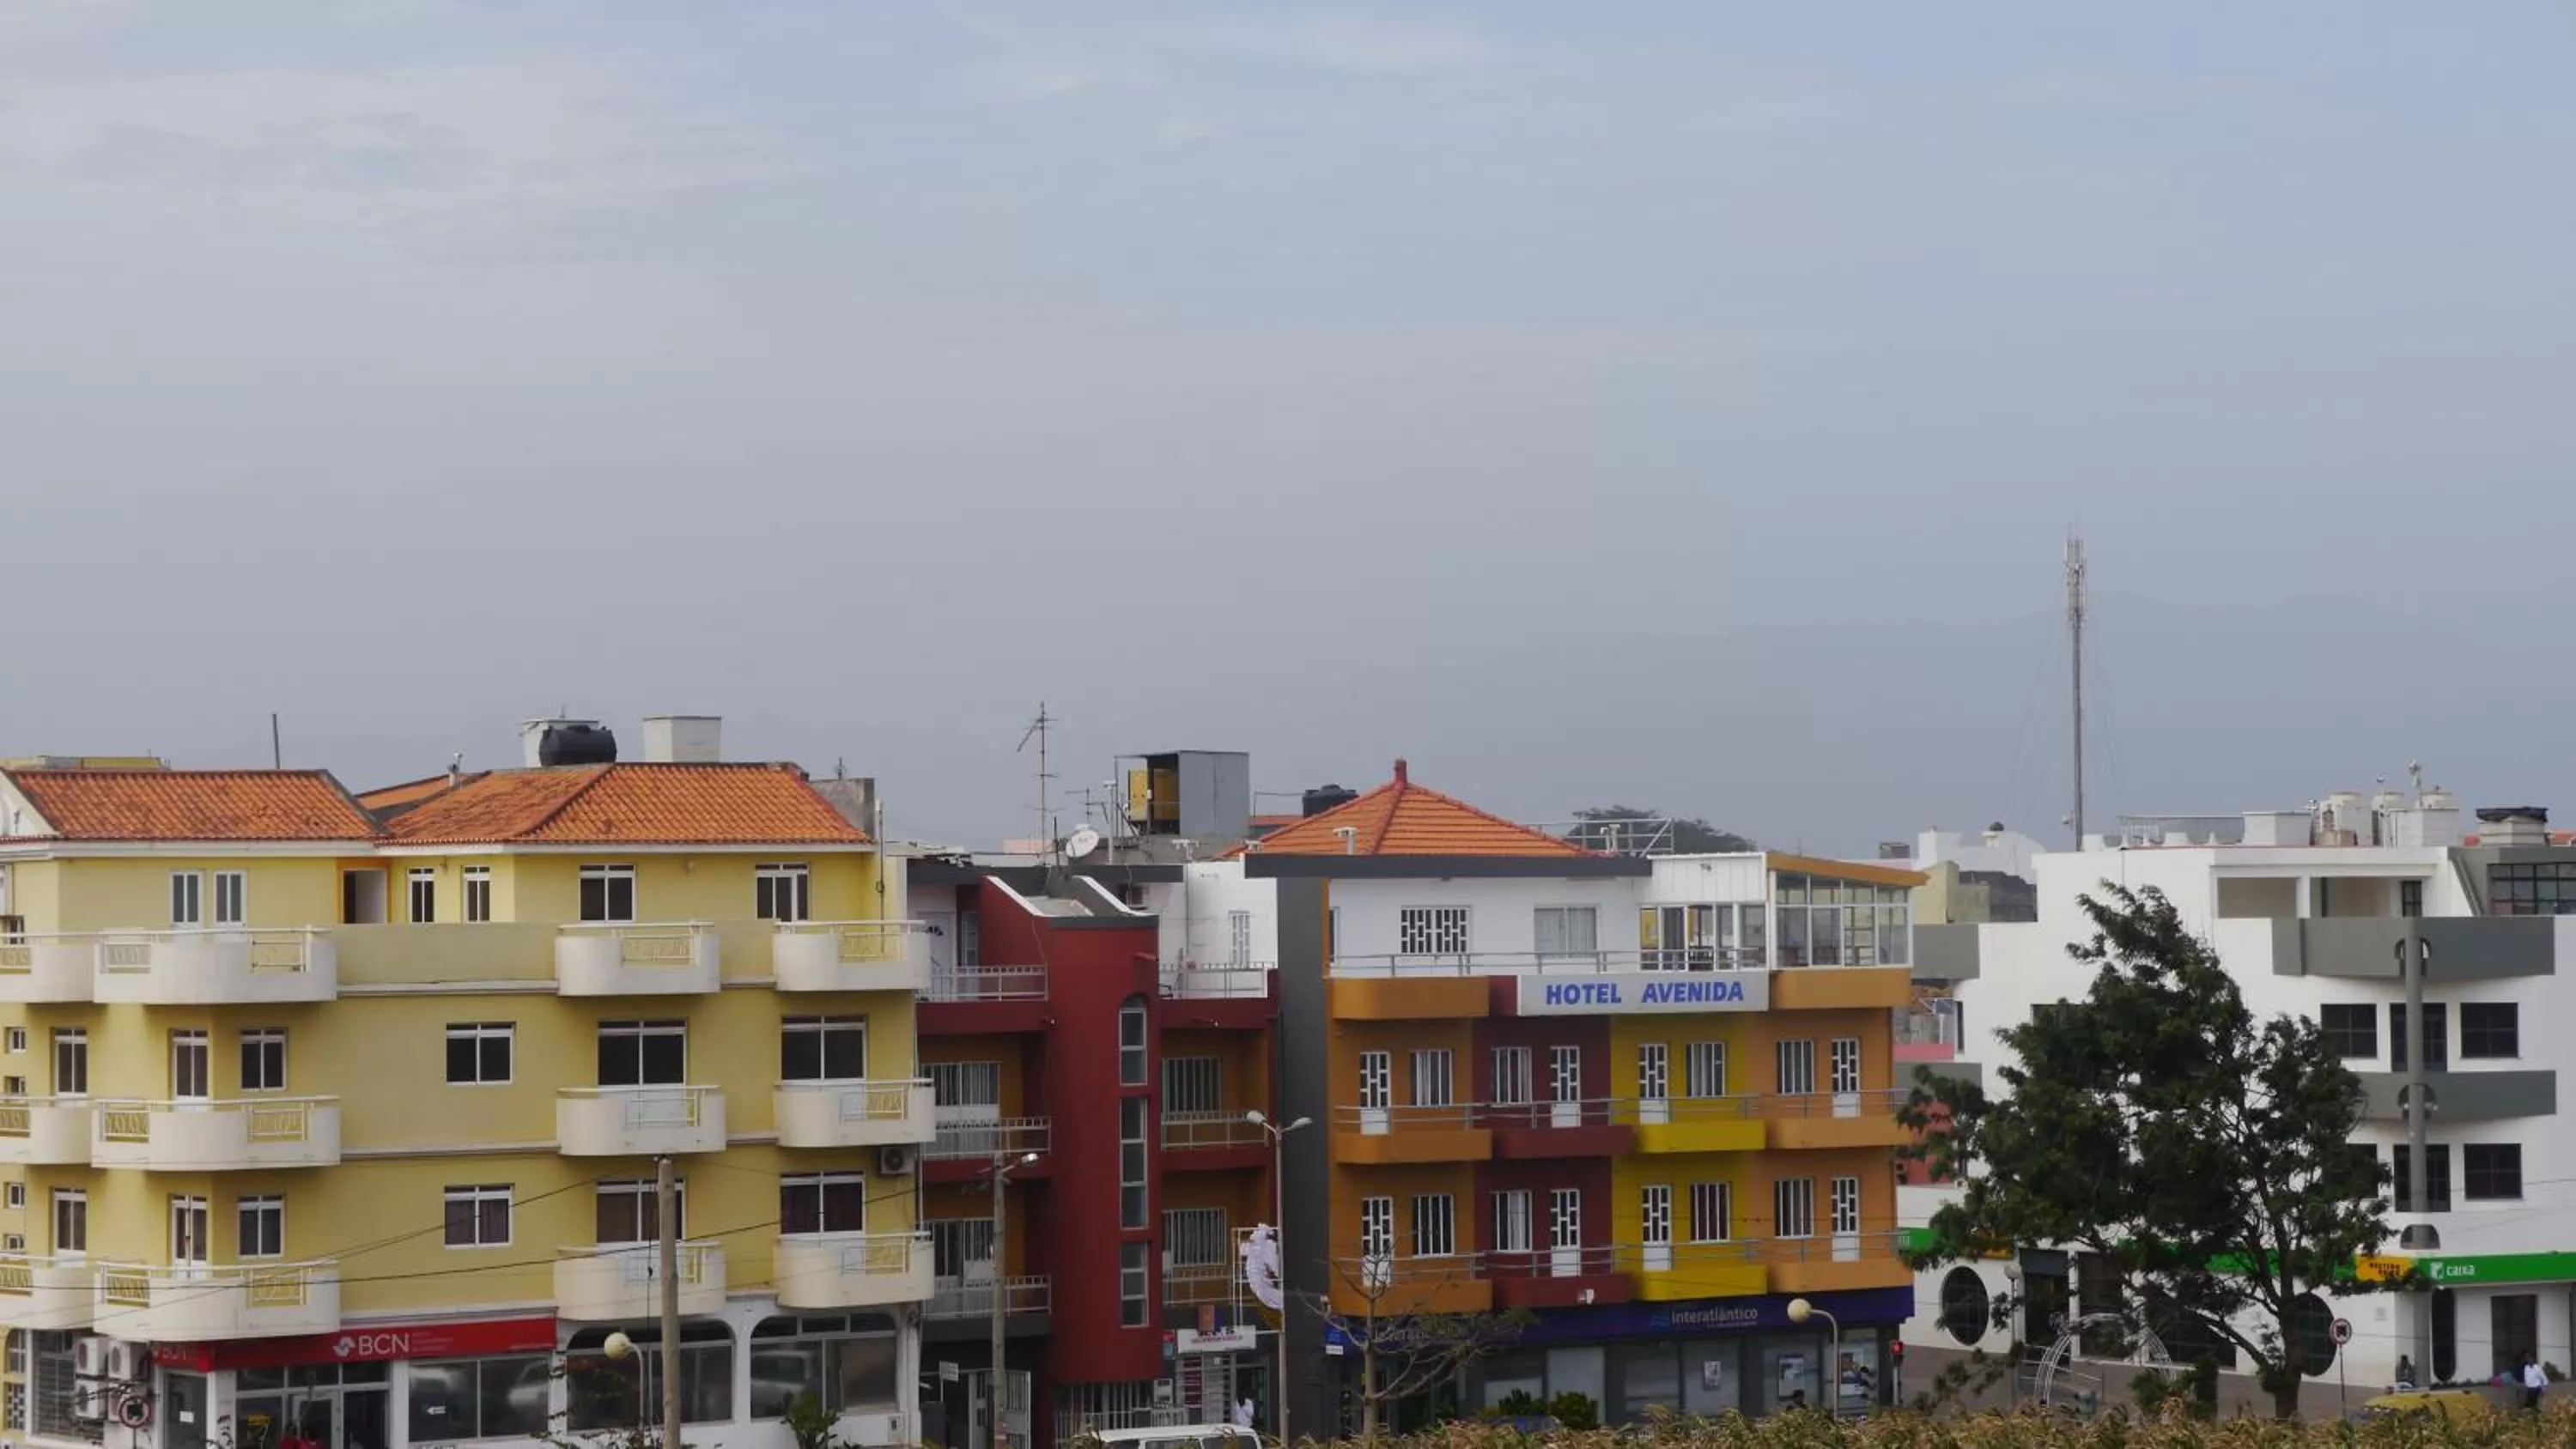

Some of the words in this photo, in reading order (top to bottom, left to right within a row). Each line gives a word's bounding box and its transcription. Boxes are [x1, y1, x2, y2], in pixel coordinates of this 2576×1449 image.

[1546, 983, 1621, 1005] HOTEL
[1642, 981, 1744, 1003] AVENIDA
[358, 1334, 410, 1356] BCN
